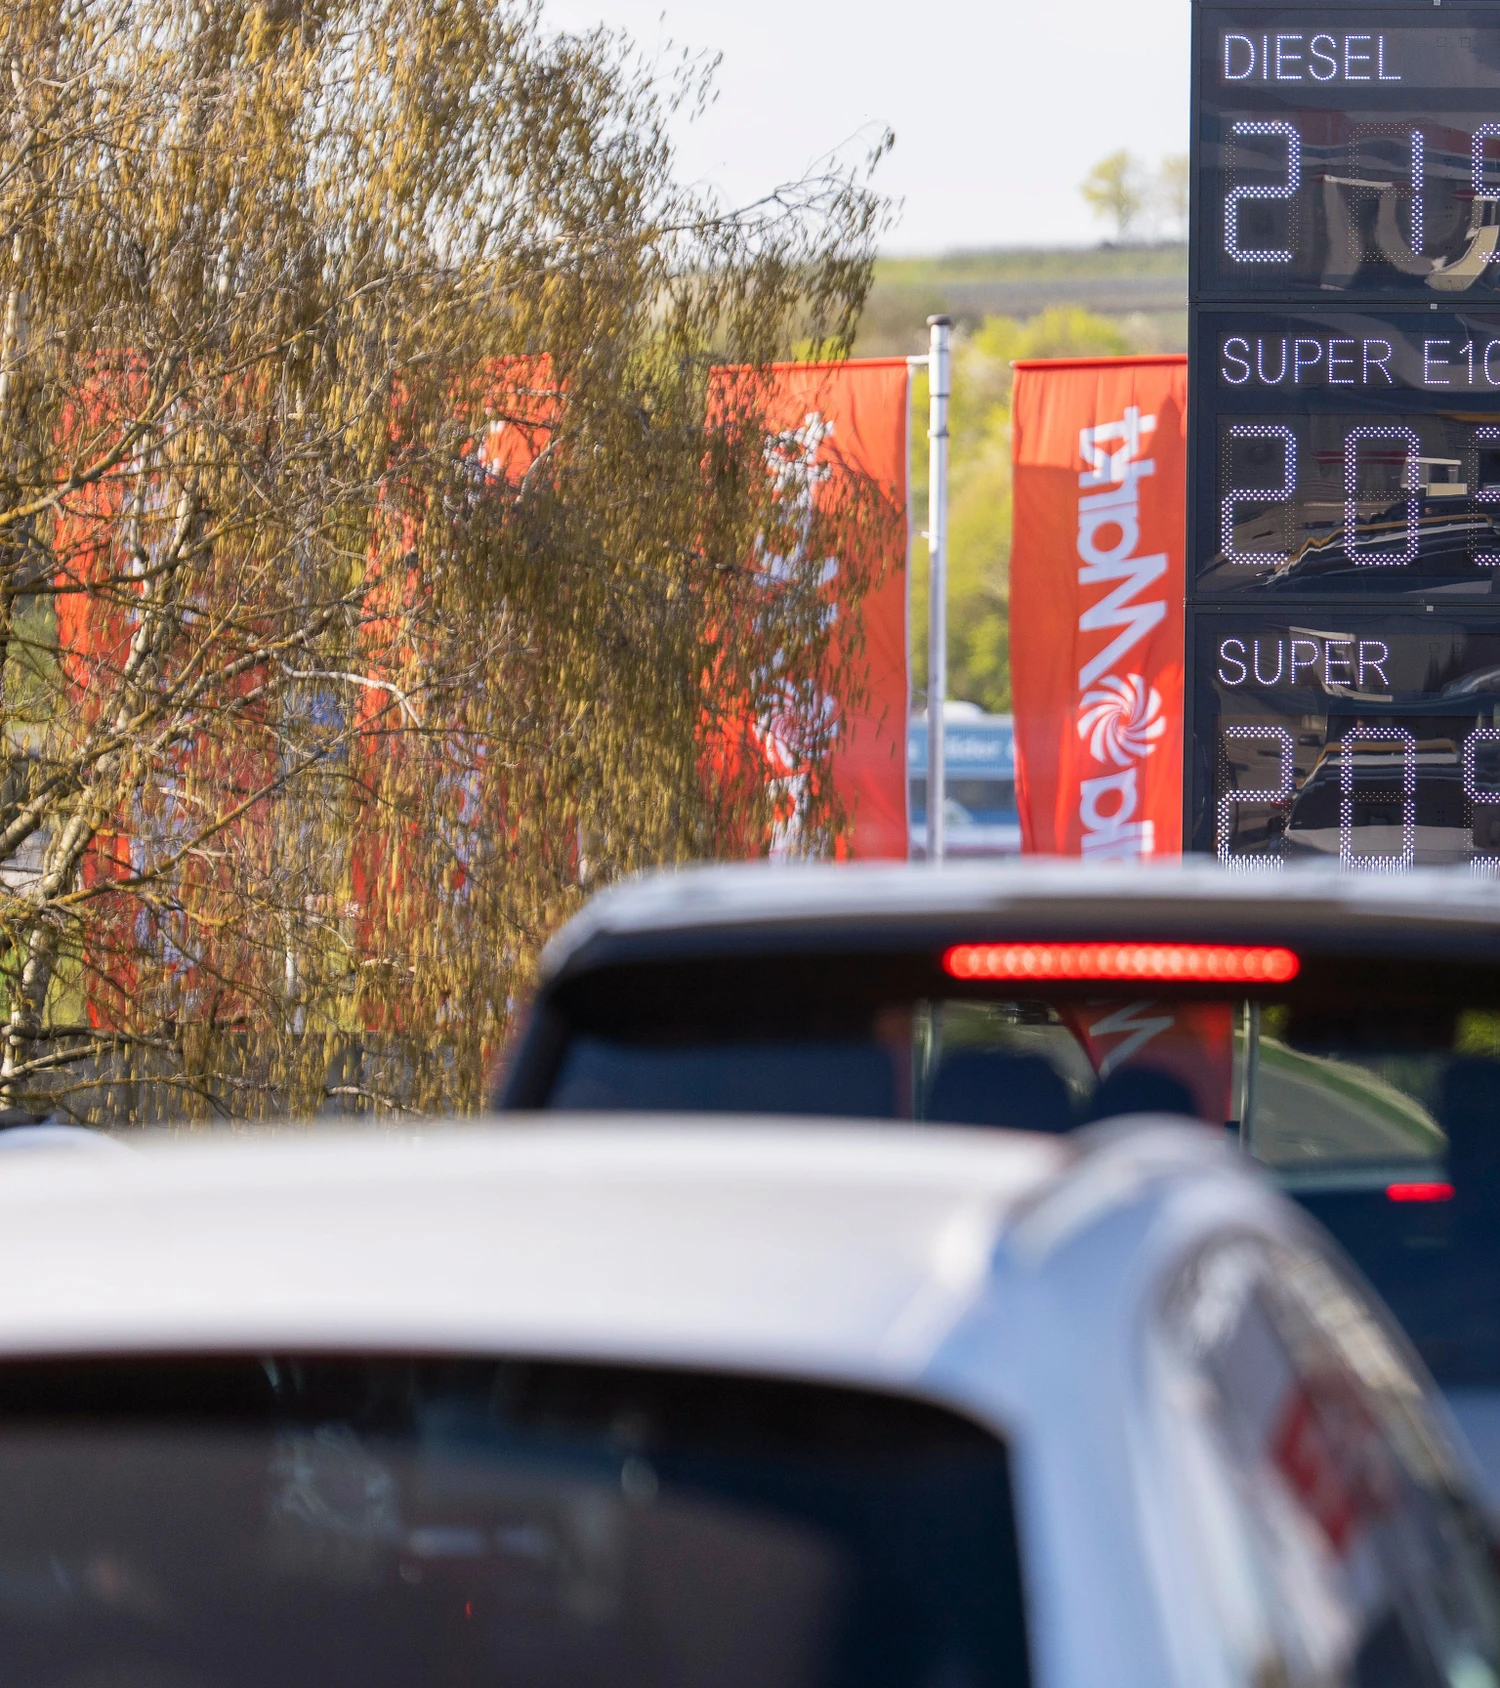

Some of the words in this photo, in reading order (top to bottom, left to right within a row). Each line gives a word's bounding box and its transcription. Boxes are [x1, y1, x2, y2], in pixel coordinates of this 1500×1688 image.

[1223, 34, 1402, 81] DIESEL
[1221, 337, 1393, 385] SUPER
[1218, 639, 1389, 686] SUPER
